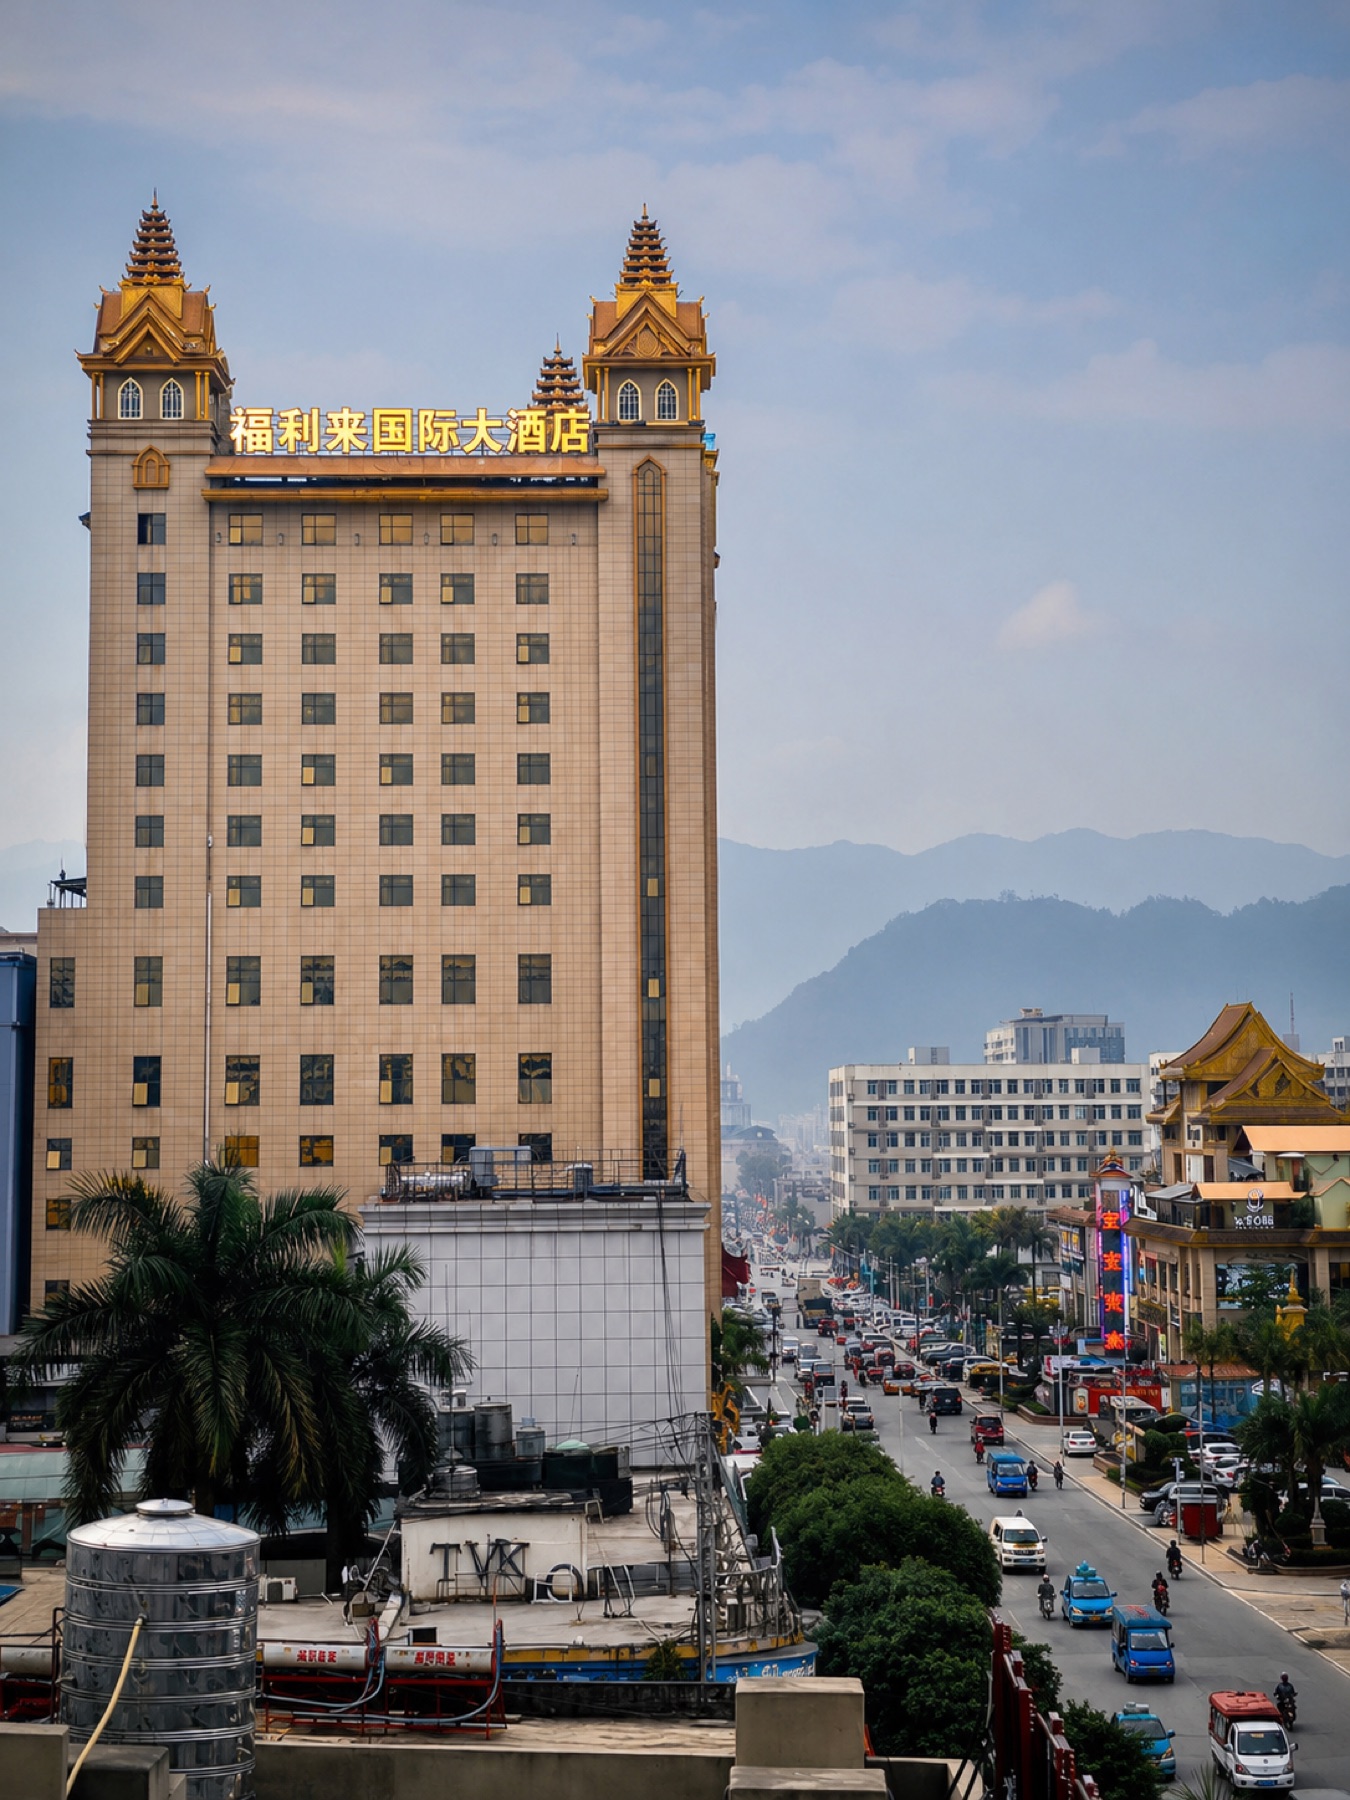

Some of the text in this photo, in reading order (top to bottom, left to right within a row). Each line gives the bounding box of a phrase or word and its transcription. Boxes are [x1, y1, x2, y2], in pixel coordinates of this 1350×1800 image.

[230, 407, 591, 454] 福利来国际大酒店
